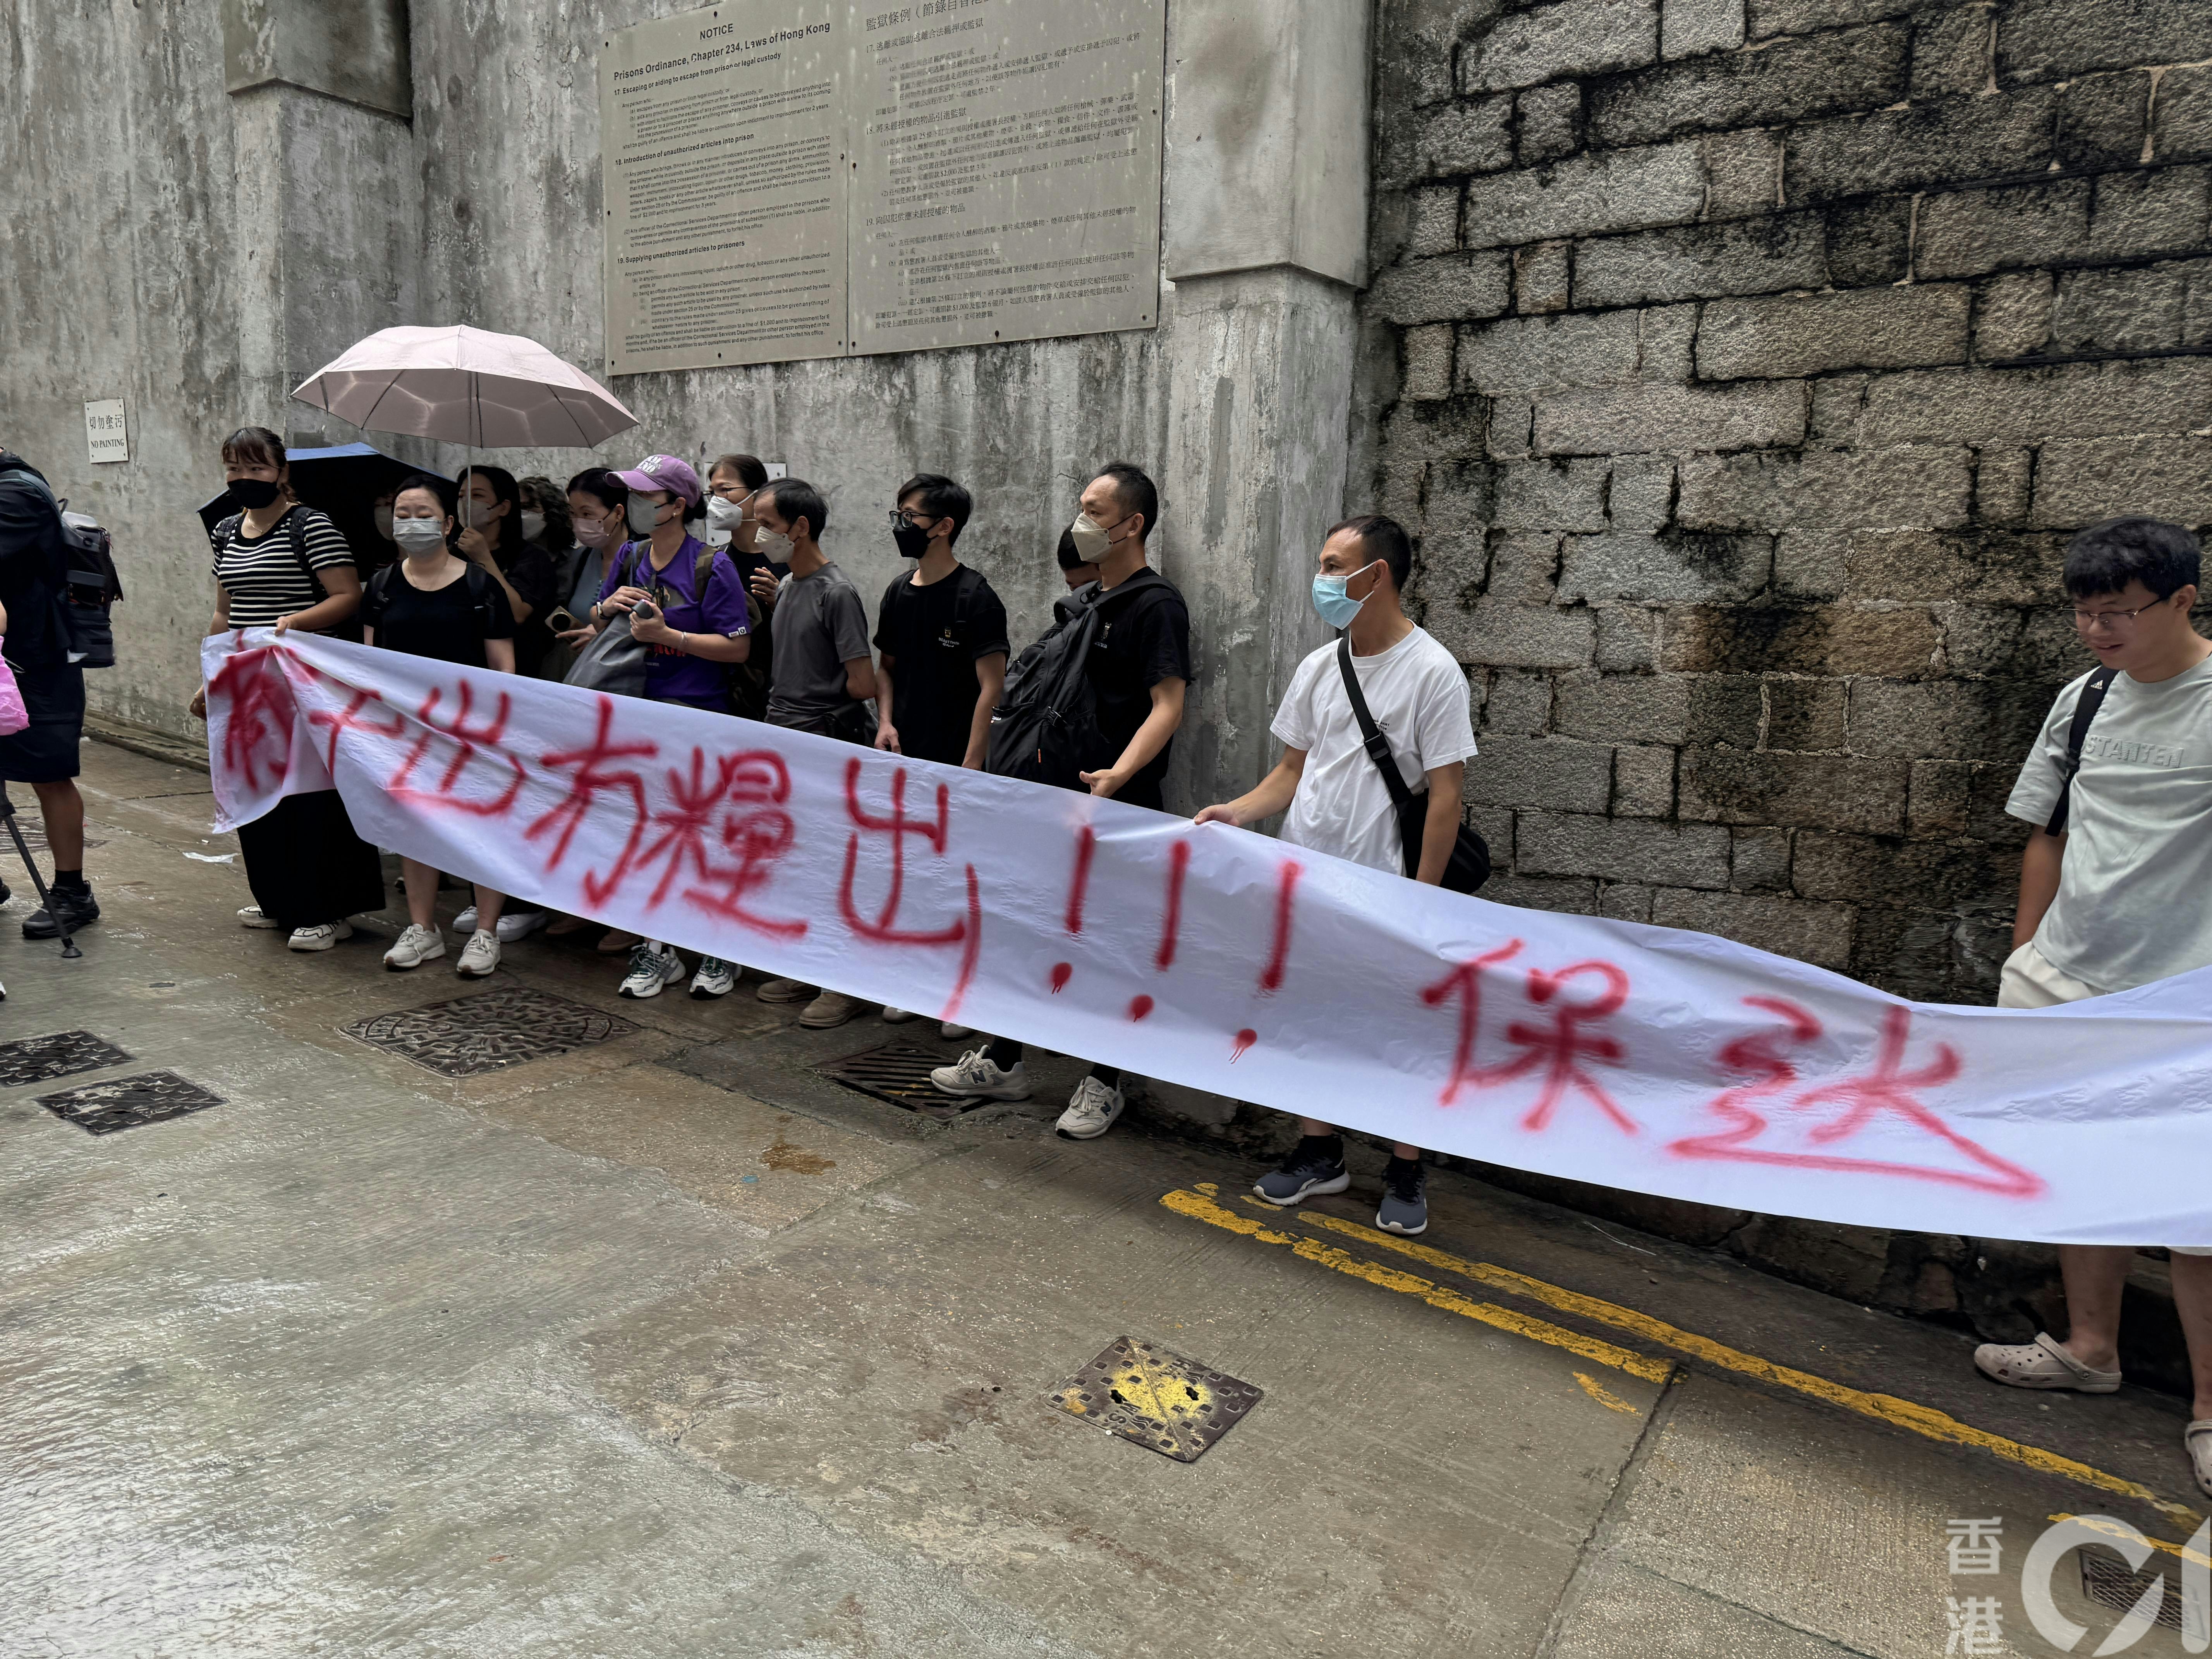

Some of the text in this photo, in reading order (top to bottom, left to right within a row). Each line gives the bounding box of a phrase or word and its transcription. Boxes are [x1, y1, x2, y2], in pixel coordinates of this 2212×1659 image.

[700, 23, 733, 40] NOTICE
[614, 22, 830, 81] Prisons Ordinance, Chapter 234, Laws of Hong Kong
[623, 84, 647, 94] Escaping
[655, 78, 672, 87] aiding
[679, 72, 699, 81] escape
[714, 64, 733, 74] prison
[741, 58, 756, 67] legal
[757, 53, 781, 64] custody
[623, 153, 656, 164] Introduction
[663, 143, 699, 156] unauthorized
[701, 140, 721, 149] articles
[735, 134, 754, 143] prison
[625, 254, 652, 263] Supplying
[653, 248, 688, 259] unauthorized
[689, 246, 709, 254] articles
[717, 241, 745, 251] prisoners
[89, 414, 124, 430] 切勿塗污
[100, 439, 124, 448] PAINTING
[970, 1070, 987, 1085] N
